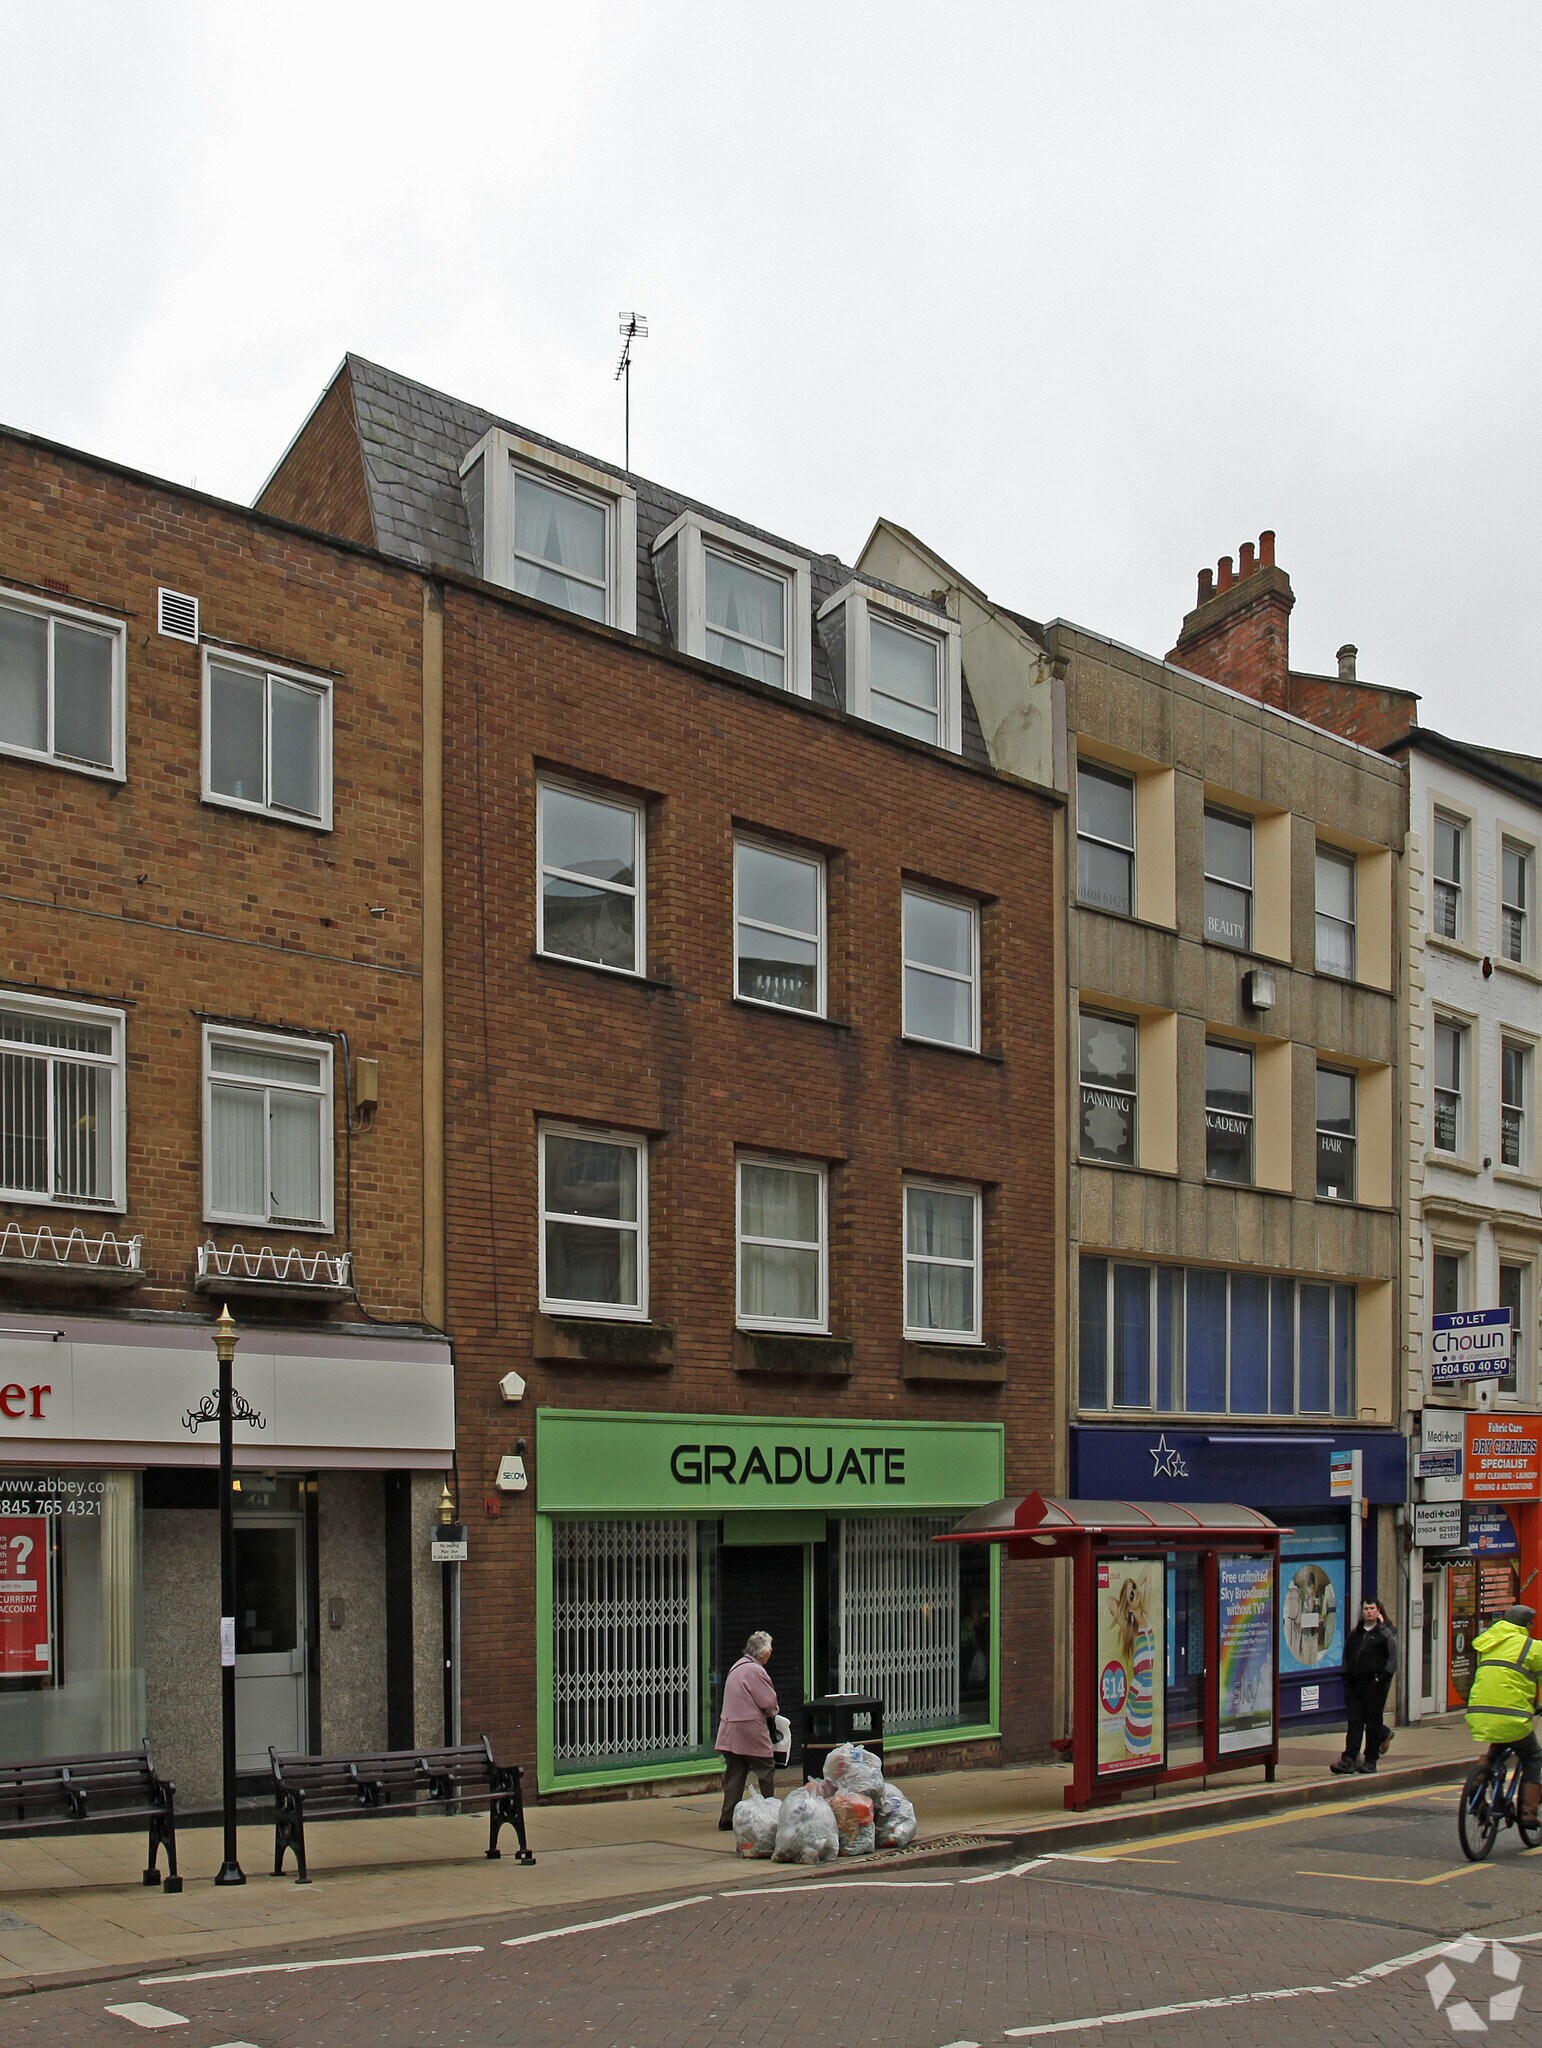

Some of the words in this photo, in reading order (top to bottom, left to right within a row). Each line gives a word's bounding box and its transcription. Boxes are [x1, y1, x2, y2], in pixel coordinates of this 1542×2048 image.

[1208, 916, 1245, 939] BEAUTY
[1321, 1137, 1342, 1154] HAIR
[1450, 1316, 1464, 1326] TO
[1467, 1314, 1486, 1325] LET
[1433, 1331, 1504, 1353] Chown
[1466, 1350, 1504, 1360] commercial
[1462, 1362, 1475, 1373] 60
[1478, 1361, 1491, 1372] 40
[1494, 1359, 1507, 1370] 50
[1488, 1422, 1508, 1433] Fabric
[1509, 1422, 1523, 1433] Care
[1472, 1439, 1493, 1456] DRY
[1493, 1439, 1538, 1456] CLEANERS
[671, 1444, 906, 1485] GRADUATE
[1481, 1459, 1528, 1469] SPECIALIST
[503, 1472, 525, 1480] SECOM
[0, 1499, 30, 1515] 845
[36, 1499, 62, 1516] 765
[67, 1500, 101, 1516] 4321
[10, 1535, 34, 1575] ?
[1221, 1571, 1237, 1584] Free
[1237, 1569, 1269, 1583] unlimited
[1220, 1587, 1235, 1602] Sky
[1234, 1586, 1270, 1599] Broadband
[1226, 1602, 1252, 1616] without
[1252, 1602, 1265, 1615] TV?
[1102, 1676, 1126, 1700] £14
